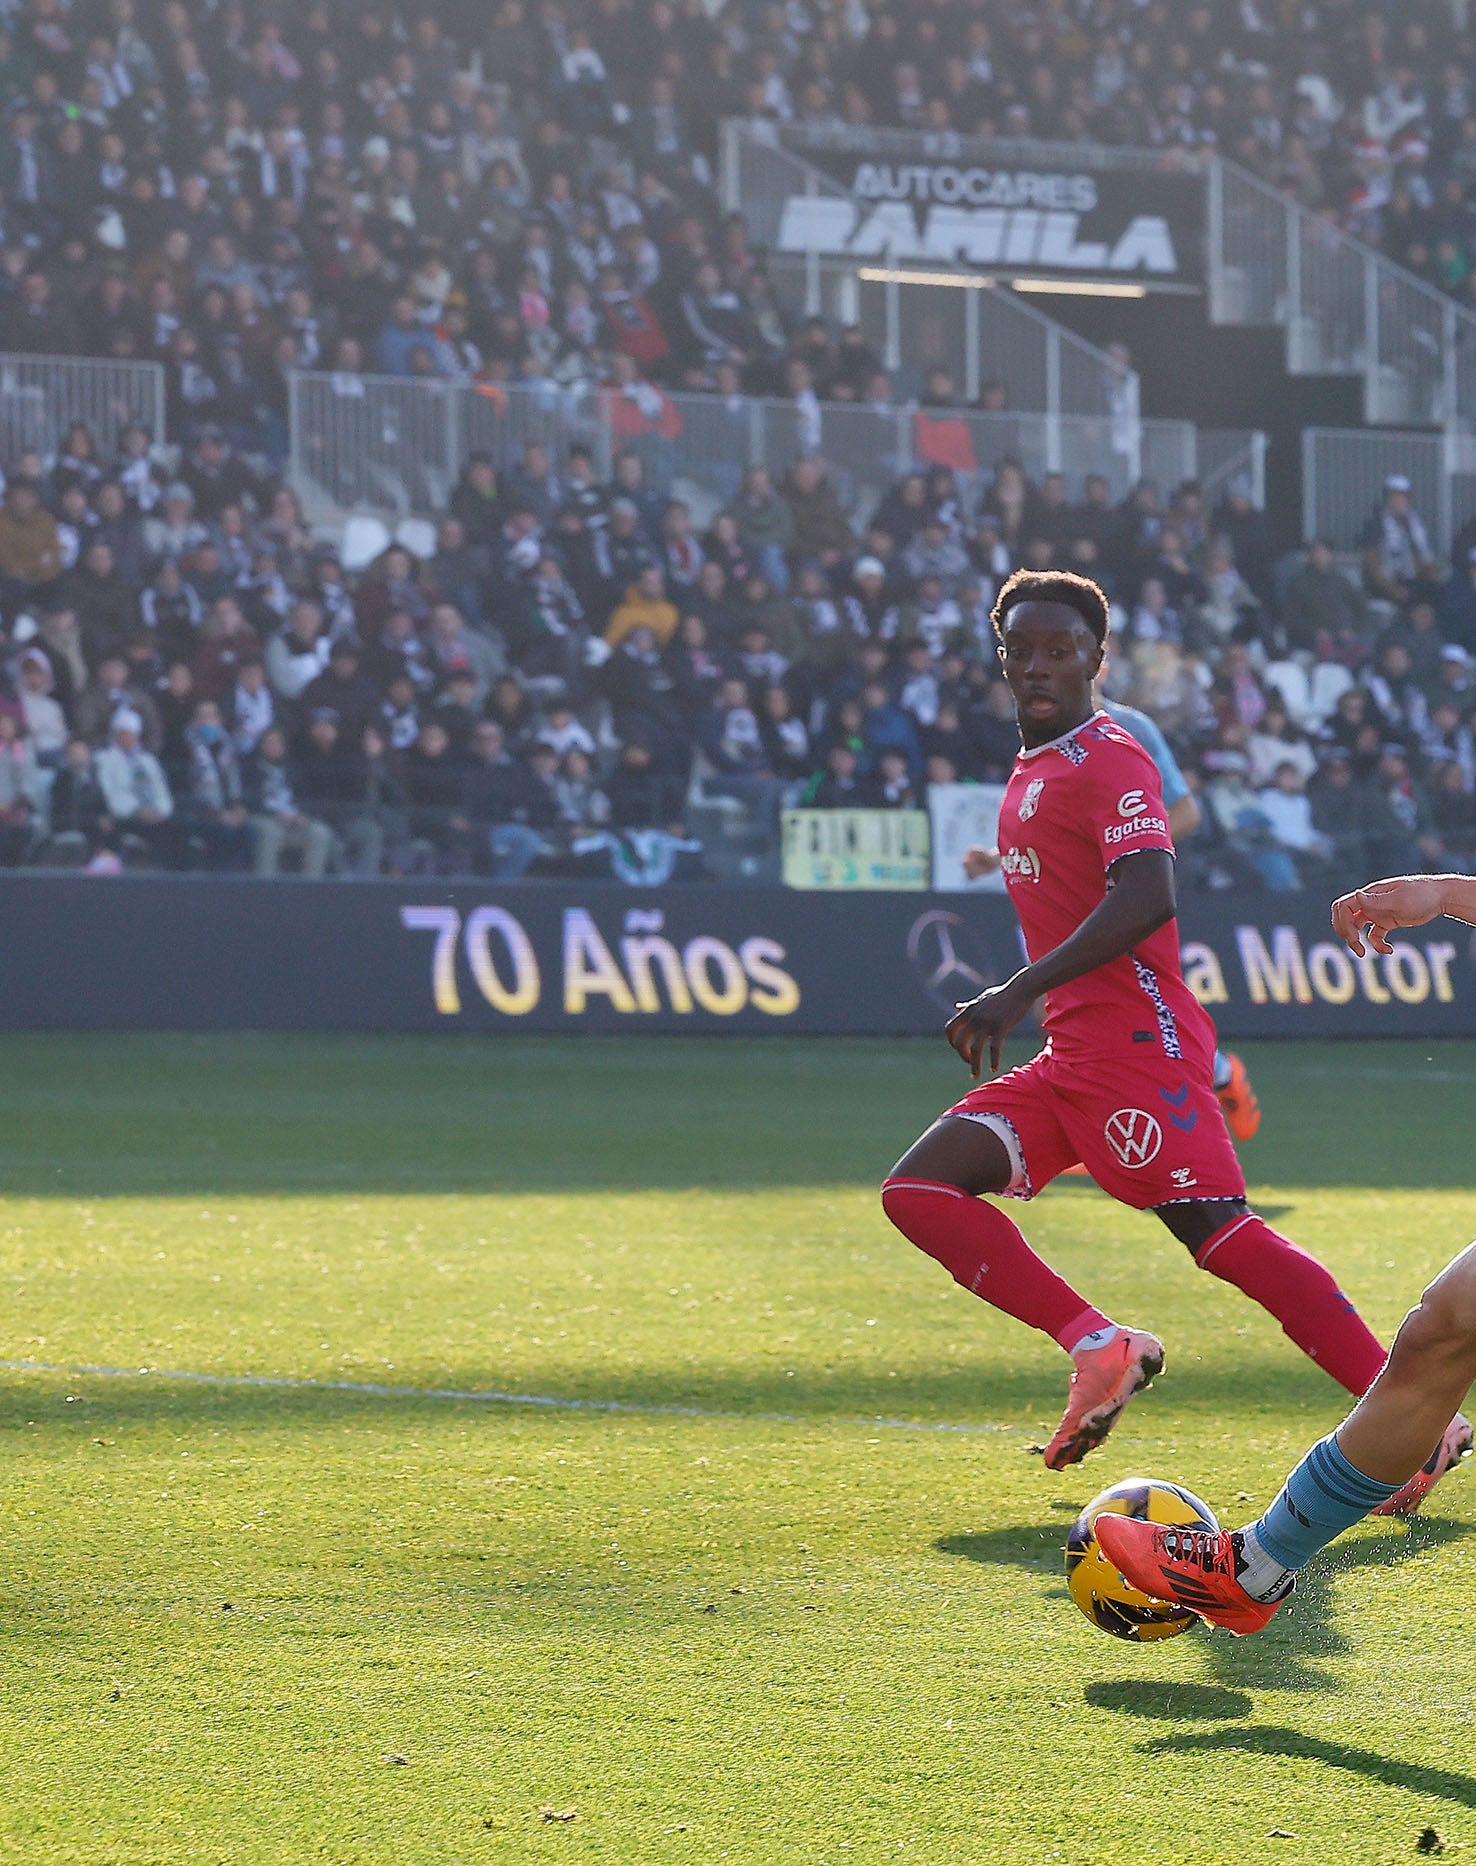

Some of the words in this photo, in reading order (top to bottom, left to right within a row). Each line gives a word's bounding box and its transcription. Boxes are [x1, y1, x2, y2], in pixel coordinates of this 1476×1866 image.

[855, 163, 1098, 211] AUTOCARES
[1103, 815, 1168, 844] Egatesa
[400, 904, 541, 1015] 70
[562, 906, 800, 1016] Años
[1235, 924, 1456, 1007] Motor
